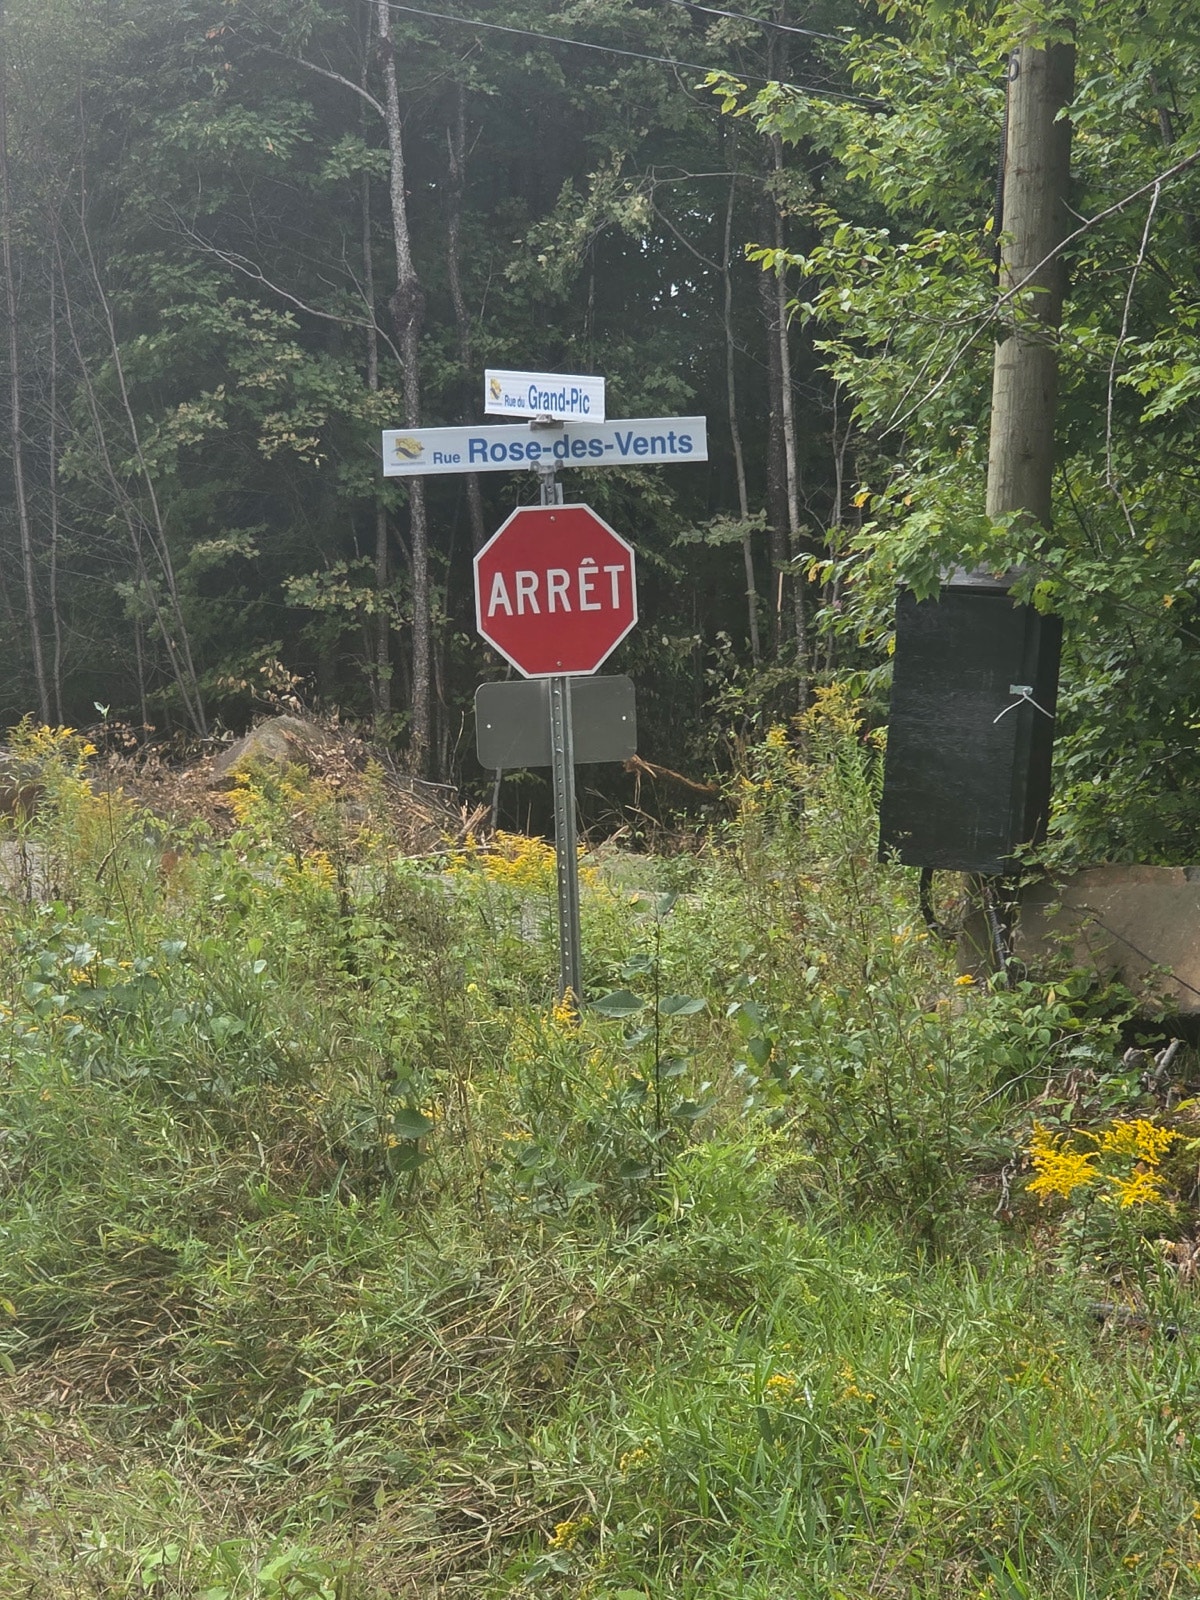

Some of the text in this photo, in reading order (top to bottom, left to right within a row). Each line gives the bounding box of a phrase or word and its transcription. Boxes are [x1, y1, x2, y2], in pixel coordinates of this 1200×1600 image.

[504, 384, 590, 414] Rue du Grand-Pic
[433, 430, 693, 465] Rue Rose-des-Vents
[487, 557, 625, 617] ARRÊT
